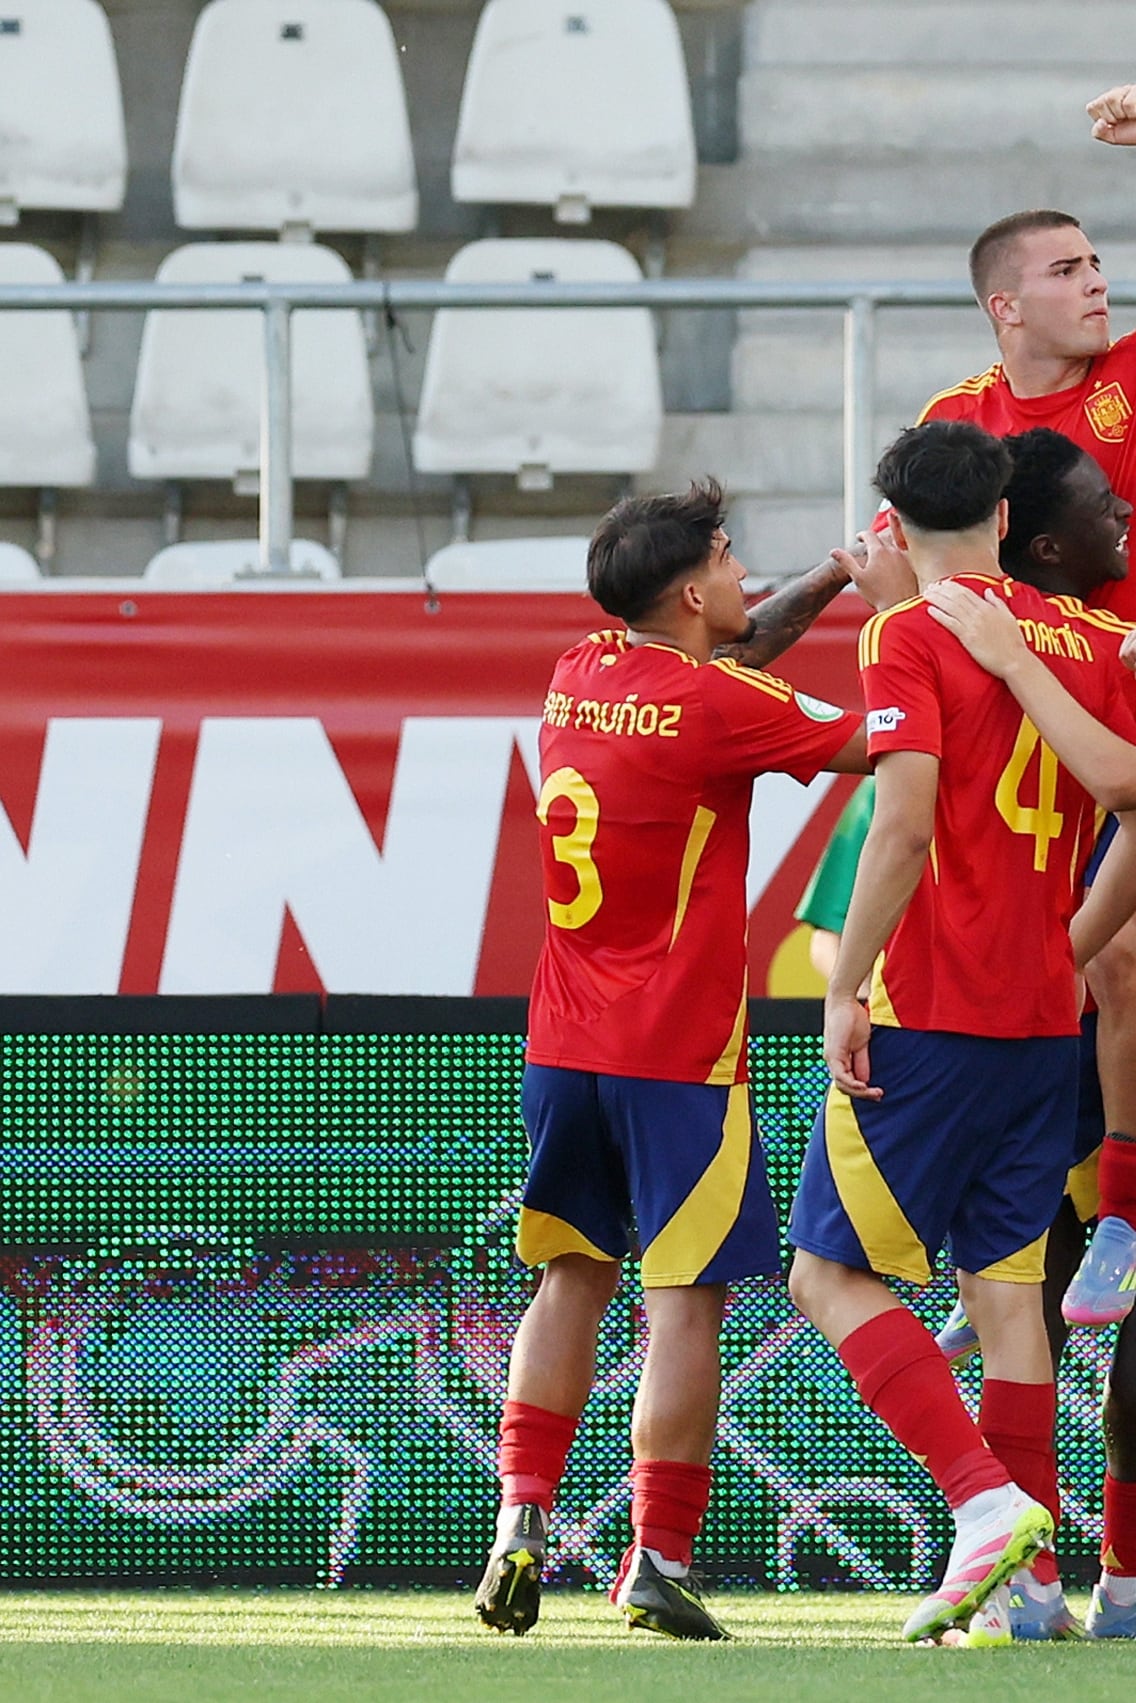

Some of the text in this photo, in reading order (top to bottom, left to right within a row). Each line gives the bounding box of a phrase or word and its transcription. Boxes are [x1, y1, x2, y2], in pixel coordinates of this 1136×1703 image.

[575, 693, 682, 737] MUÑOZ
[995, 712, 1064, 872] 4
[536, 766, 604, 930] 3
